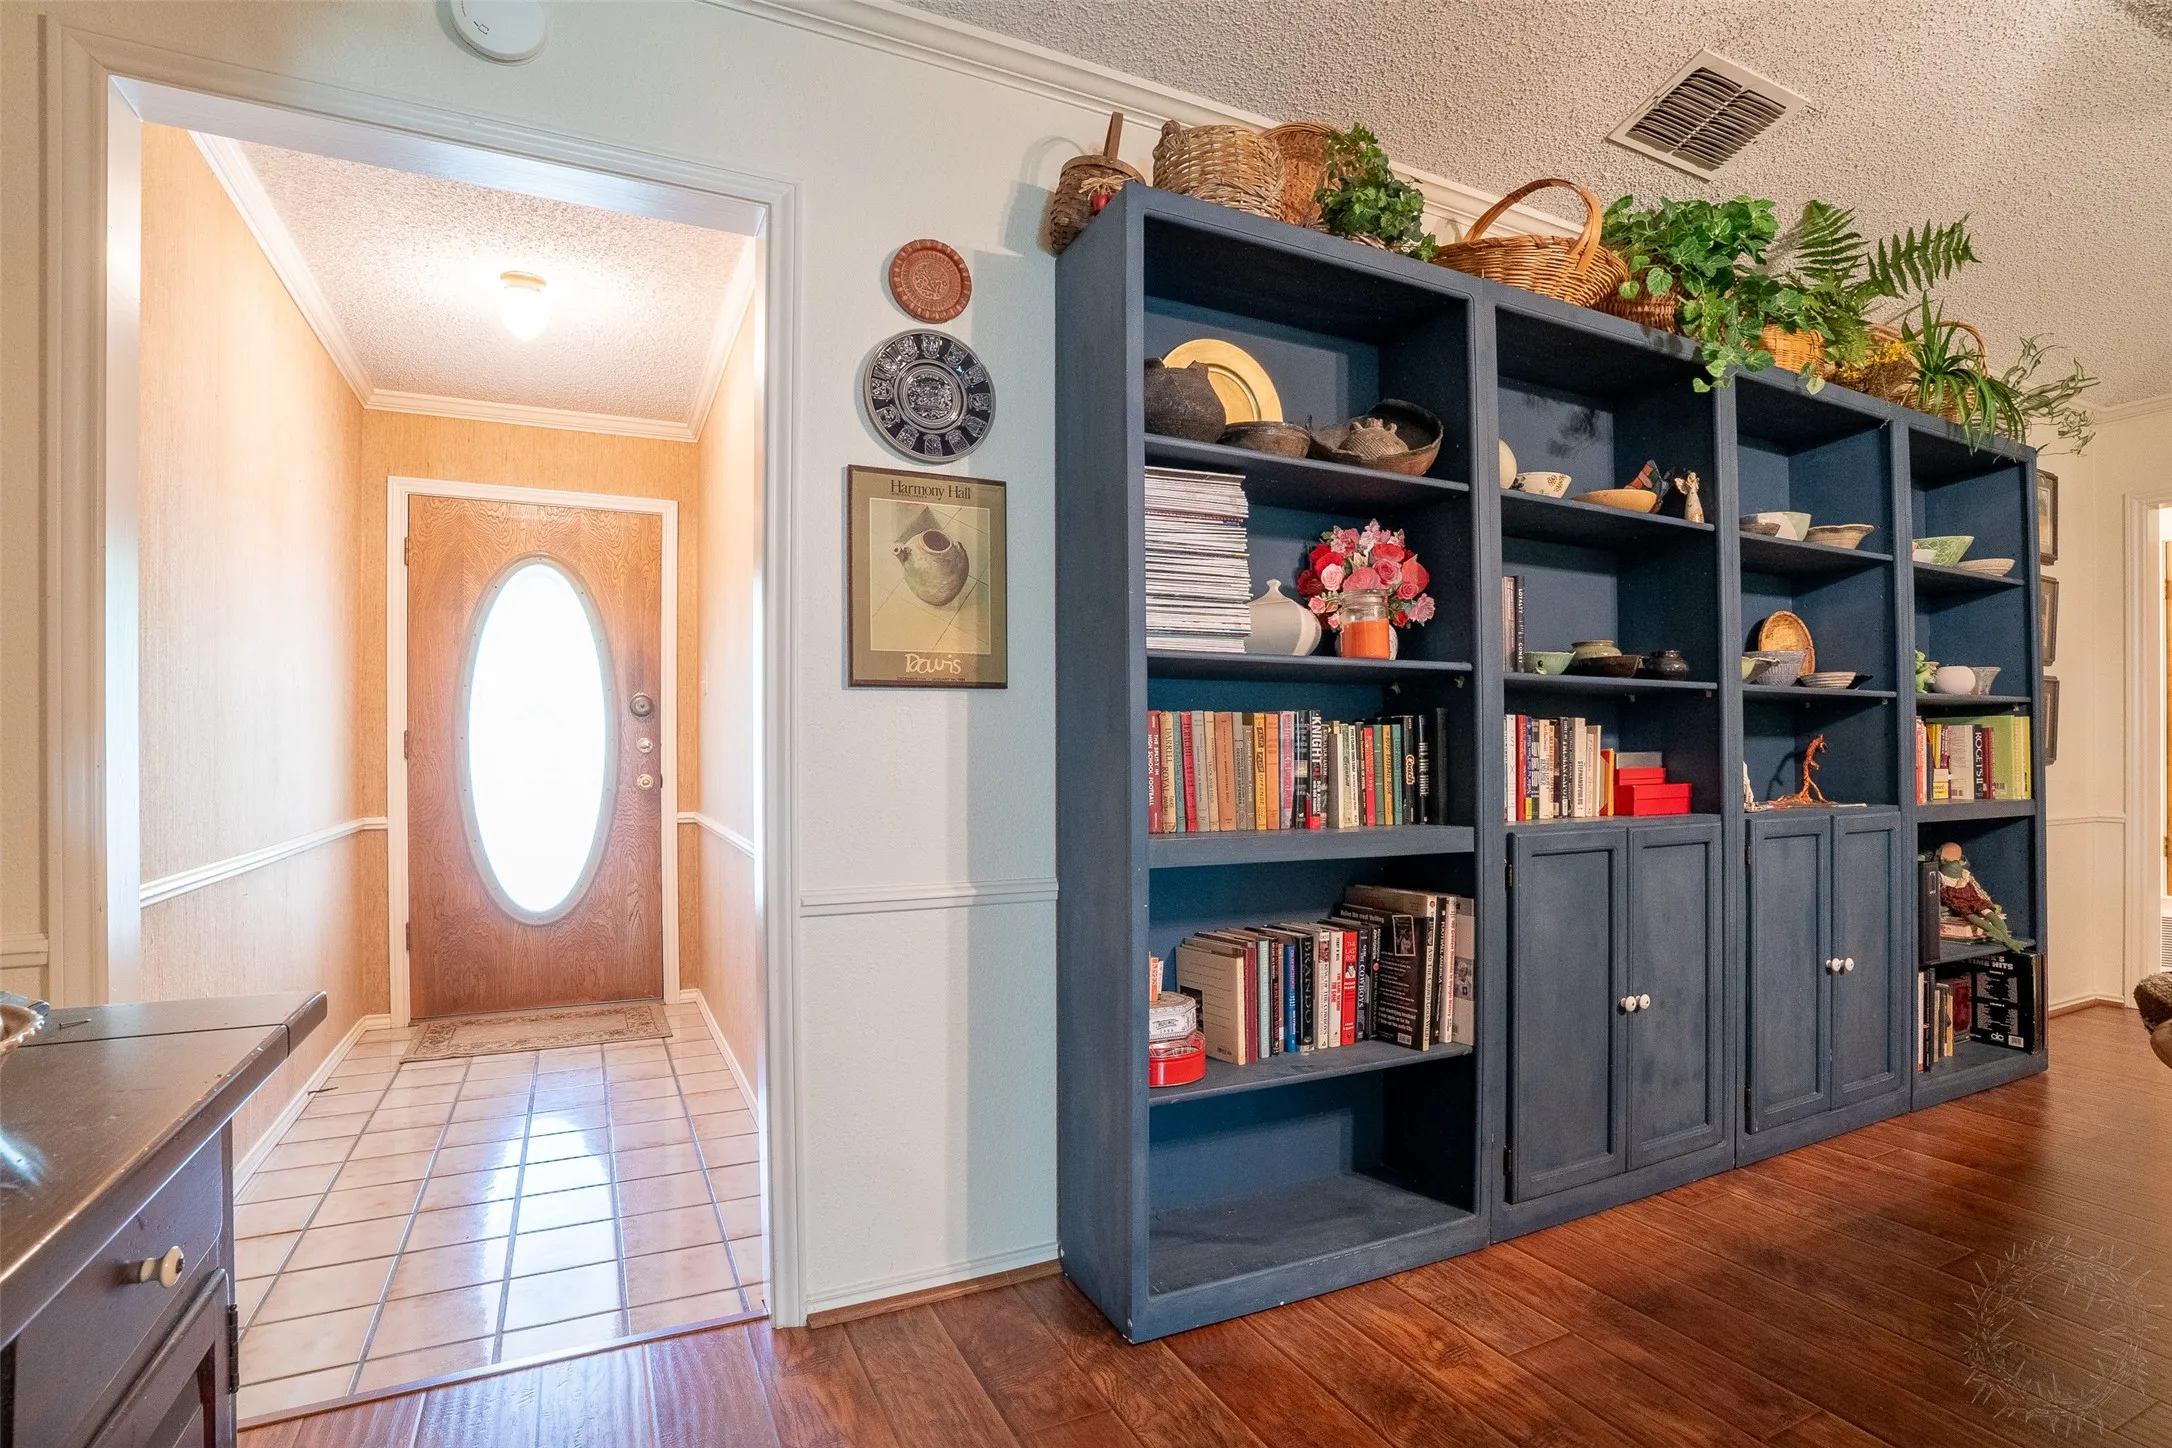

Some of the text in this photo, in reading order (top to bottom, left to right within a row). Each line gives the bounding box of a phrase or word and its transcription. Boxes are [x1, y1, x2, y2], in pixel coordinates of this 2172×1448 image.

[891, 480, 970, 502] Harmony Hall
[1165, 728, 1173, 764] DARRELL
[1312, 716, 1321, 765] KNIGHT
[1975, 732, 1983, 777] ROGET'S
[1161, 766, 1169, 793] ROYAL
[1405, 754, 1415, 785] Coach
[1969, 958, 2014, 970] TIME HITS
[1358, 964, 1366, 1008] COWBOYS
